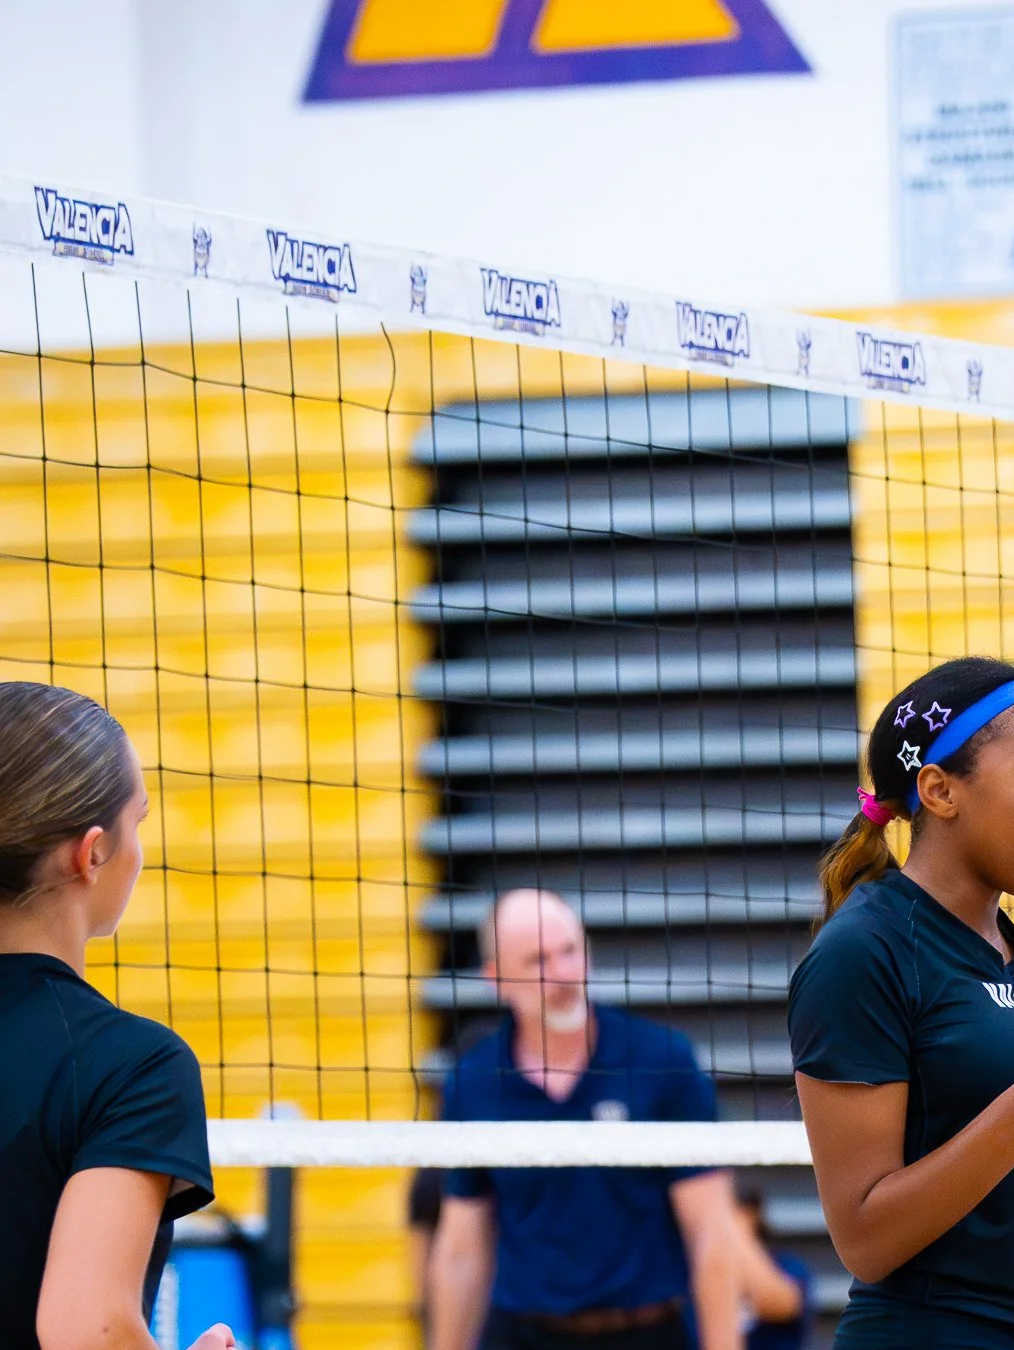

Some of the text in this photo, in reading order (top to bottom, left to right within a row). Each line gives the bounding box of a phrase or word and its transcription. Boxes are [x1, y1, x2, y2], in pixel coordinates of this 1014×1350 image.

[34, 186, 134, 255] VALENCIA
[266, 229, 357, 293] VALENCIA
[480, 268, 561, 328] VALENCIA
[676, 301, 750, 358] VALENCIA
[856, 331, 926, 385] VALENCIA
